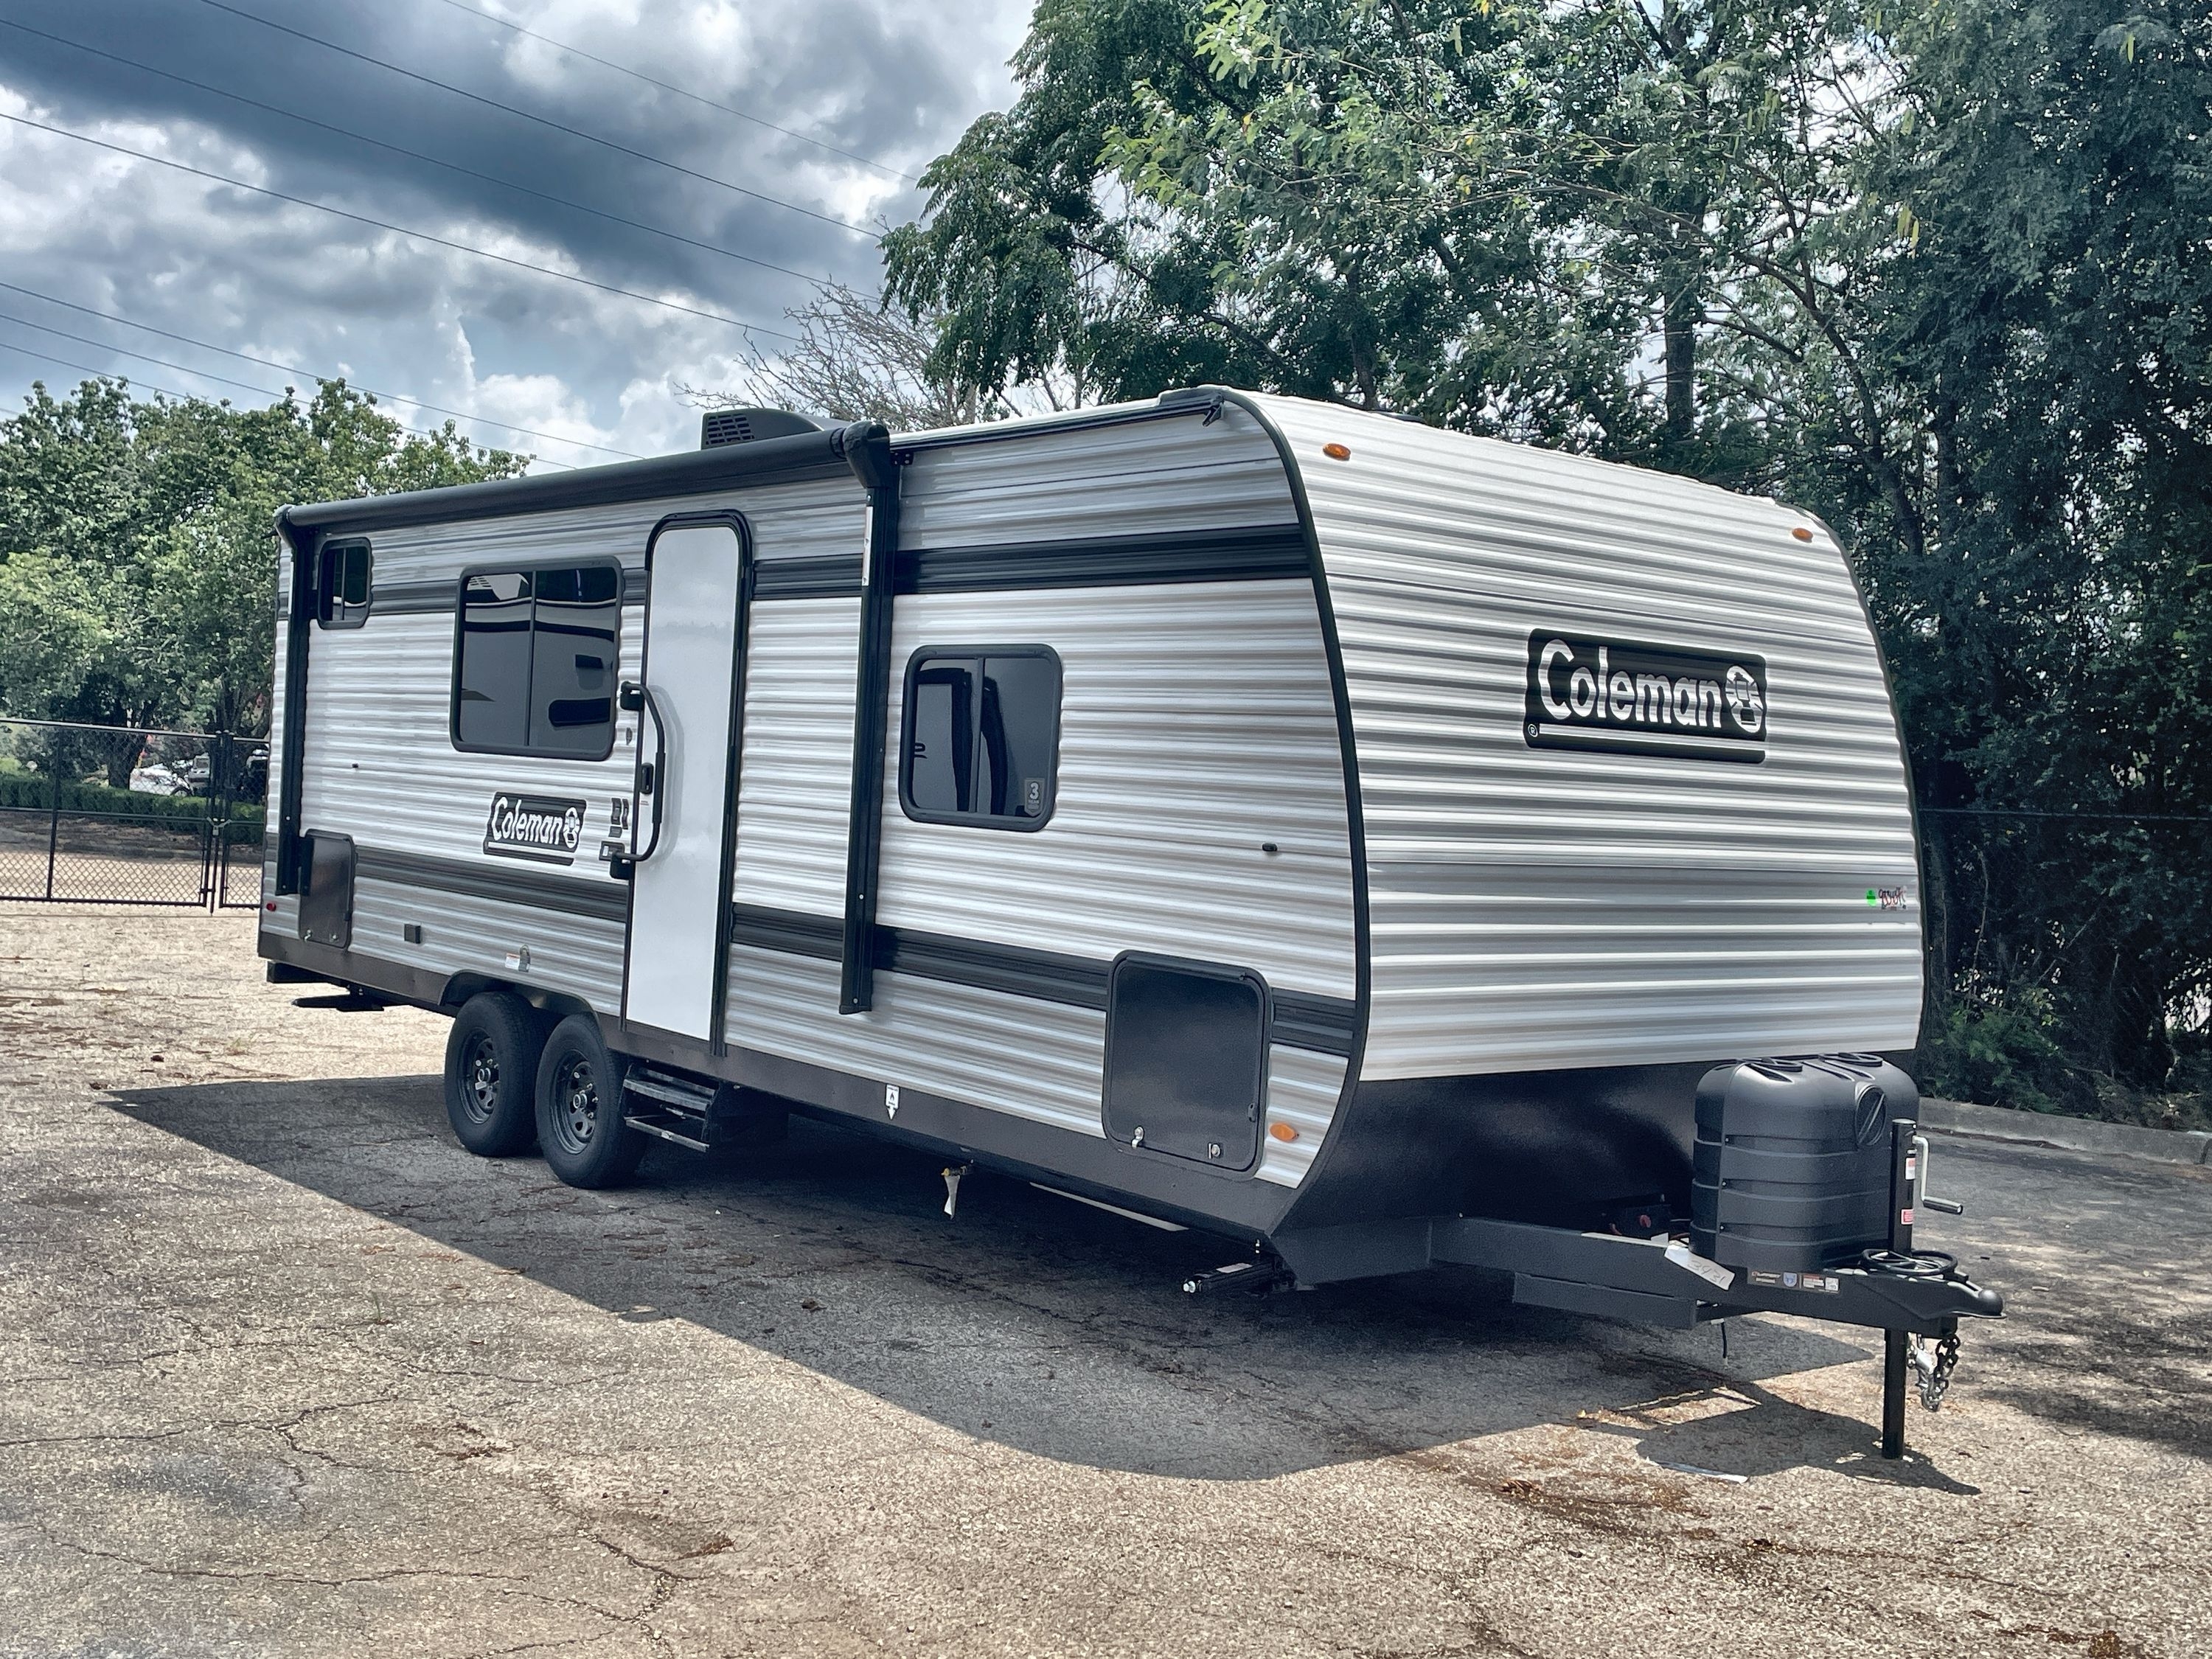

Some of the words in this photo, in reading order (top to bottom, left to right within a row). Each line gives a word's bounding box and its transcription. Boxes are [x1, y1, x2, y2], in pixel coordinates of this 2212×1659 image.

[1538, 639, 1722, 728] Coleman
[1029, 782, 1039, 800] 3
[491, 796, 563, 845] Coleman
